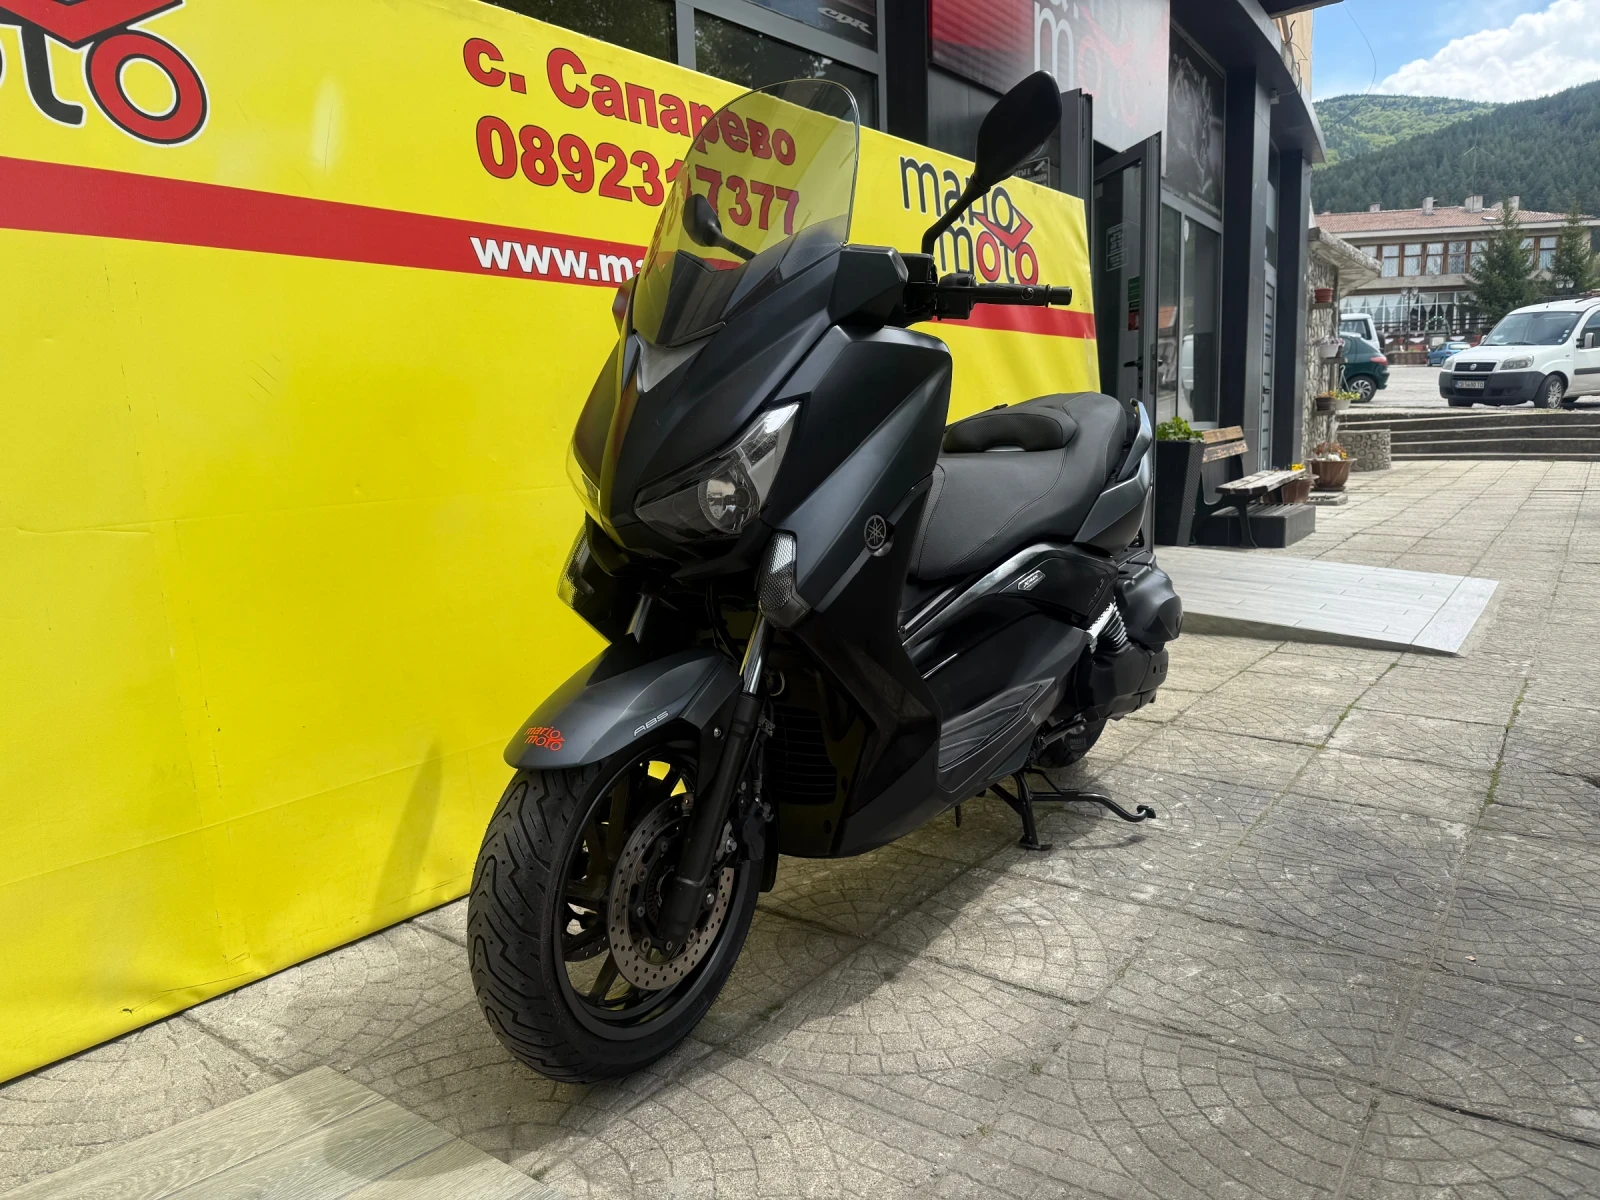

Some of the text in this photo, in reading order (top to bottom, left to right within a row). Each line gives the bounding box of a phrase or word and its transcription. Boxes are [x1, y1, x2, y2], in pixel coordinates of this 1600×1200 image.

[463, 37, 797, 166] с. Сапарево
[524, 725, 561, 740] mario
[633, 710, 669, 737] ABS
[524, 734, 563, 751] moto
